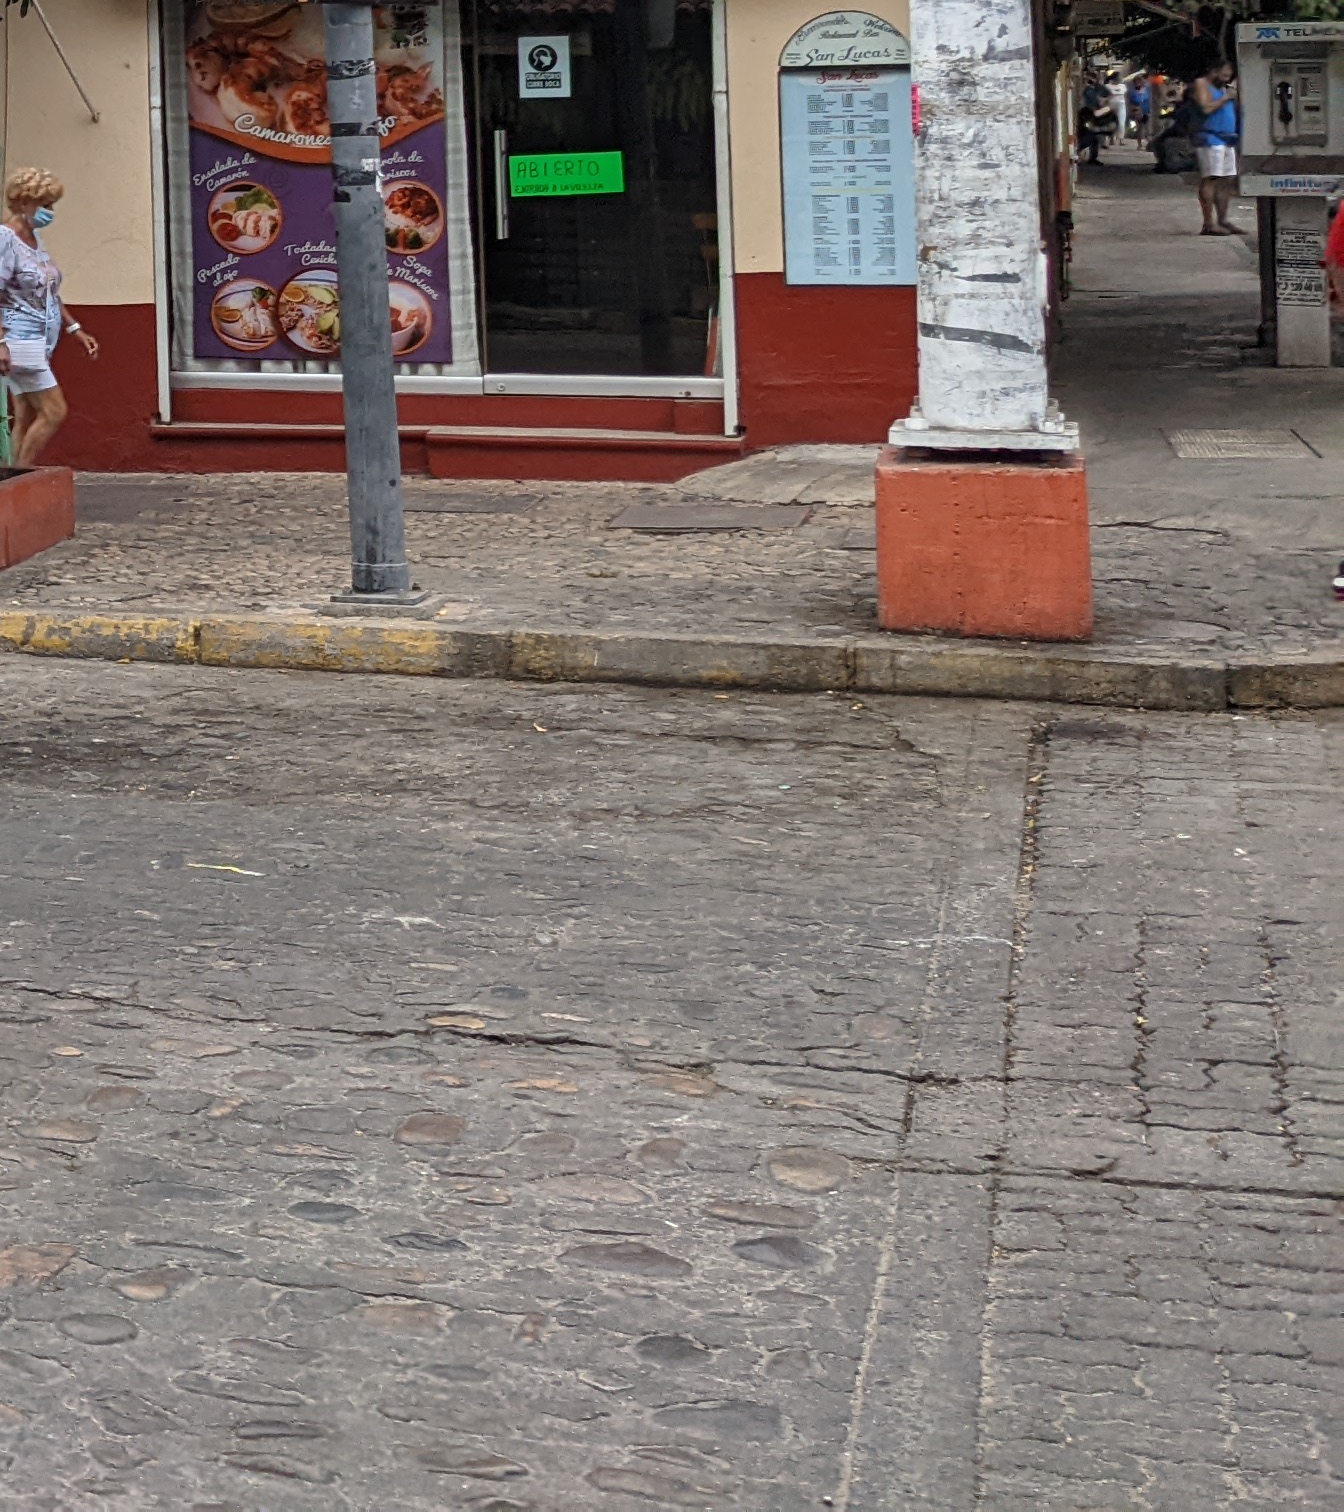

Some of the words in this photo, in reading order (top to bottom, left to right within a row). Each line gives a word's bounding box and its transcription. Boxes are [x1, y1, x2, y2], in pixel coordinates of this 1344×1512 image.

[803, 48, 835, 66] San
[838, 45, 892, 63] Lucas
[408, 150, 424, 163] de
[192, 157, 240, 186] Ensalada
[241, 152, 257, 165] de
[516, 159, 600, 179] ABIERTO
[206, 169, 250, 192] Camarón
[197, 254, 240, 282] Pescado
[301, 253, 337, 266] Cevich
[403, 256, 433, 277] Sopa
